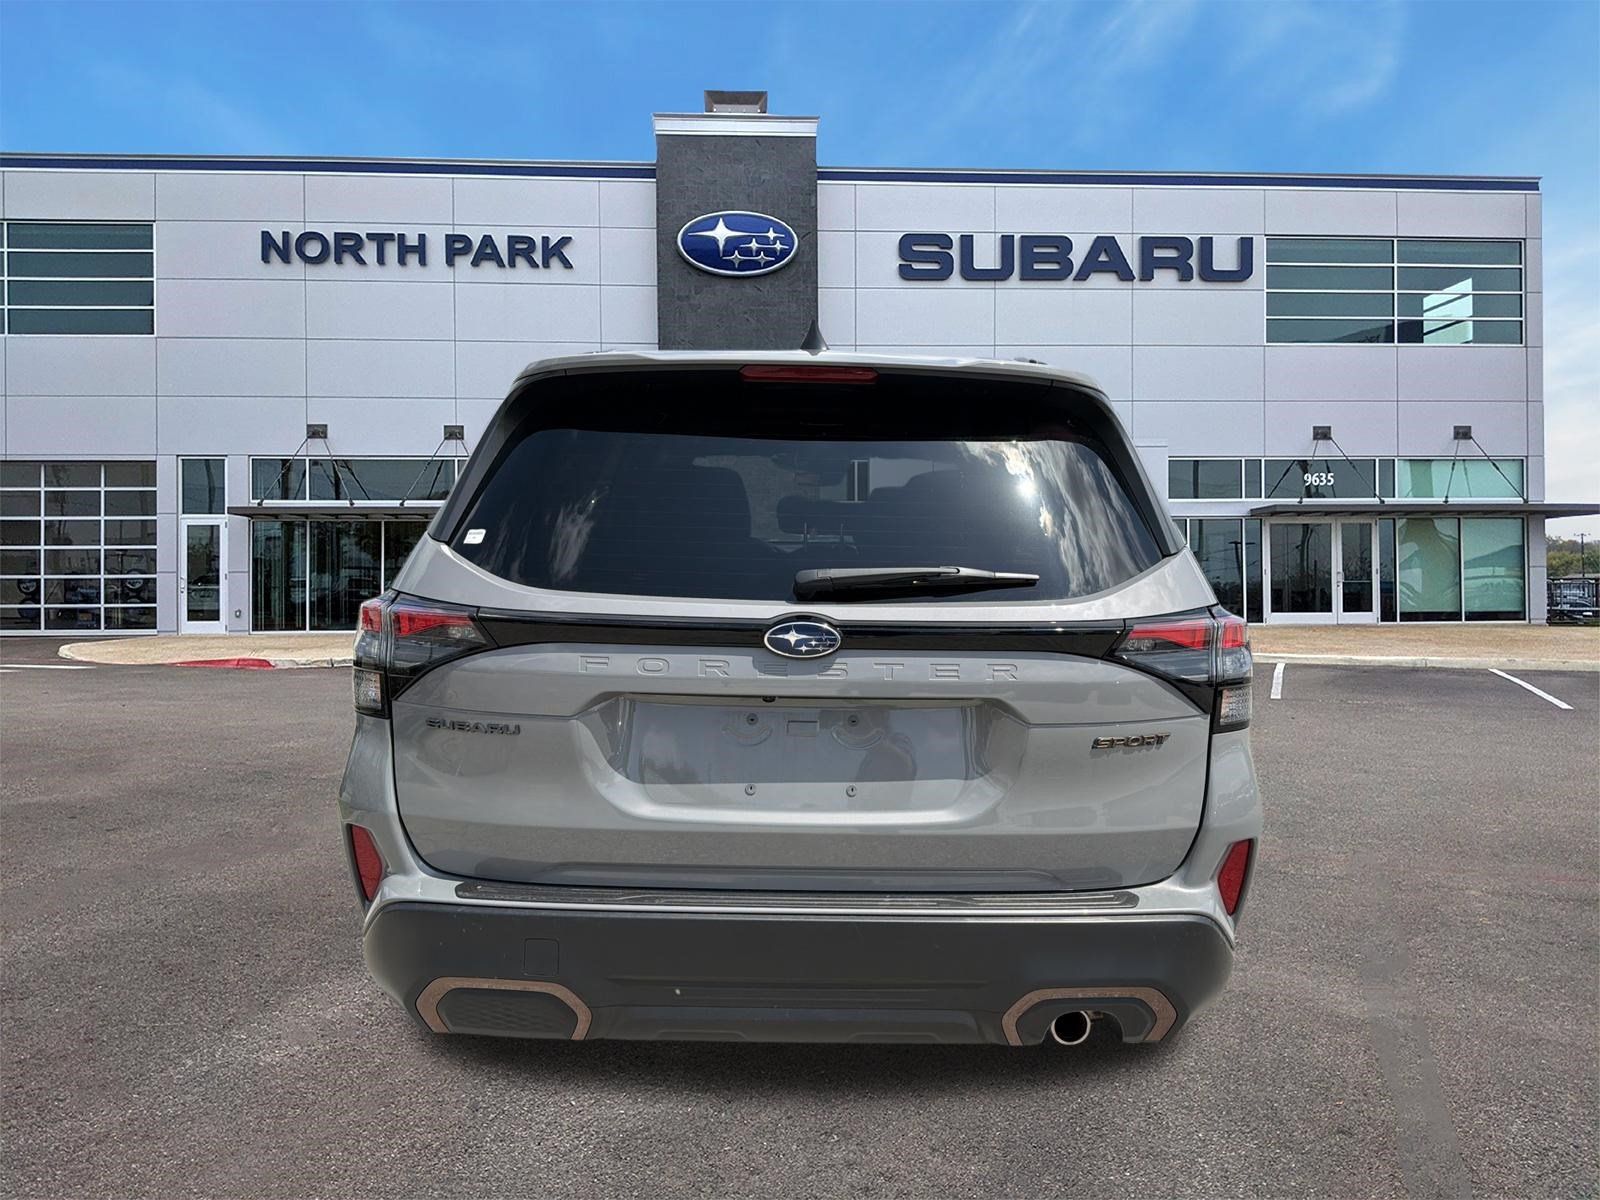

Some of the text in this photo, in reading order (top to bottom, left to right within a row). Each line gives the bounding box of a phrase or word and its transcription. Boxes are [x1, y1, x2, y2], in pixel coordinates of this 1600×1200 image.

[261, 230, 574, 269] NORTH PARK
[898, 233, 1254, 282] SUBARU
[1303, 472, 1335, 486] 9635
[580, 656, 1020, 681] FORESTER
[427, 718, 521, 735] SUBARU
[1092, 733, 1171, 749] SPORT
